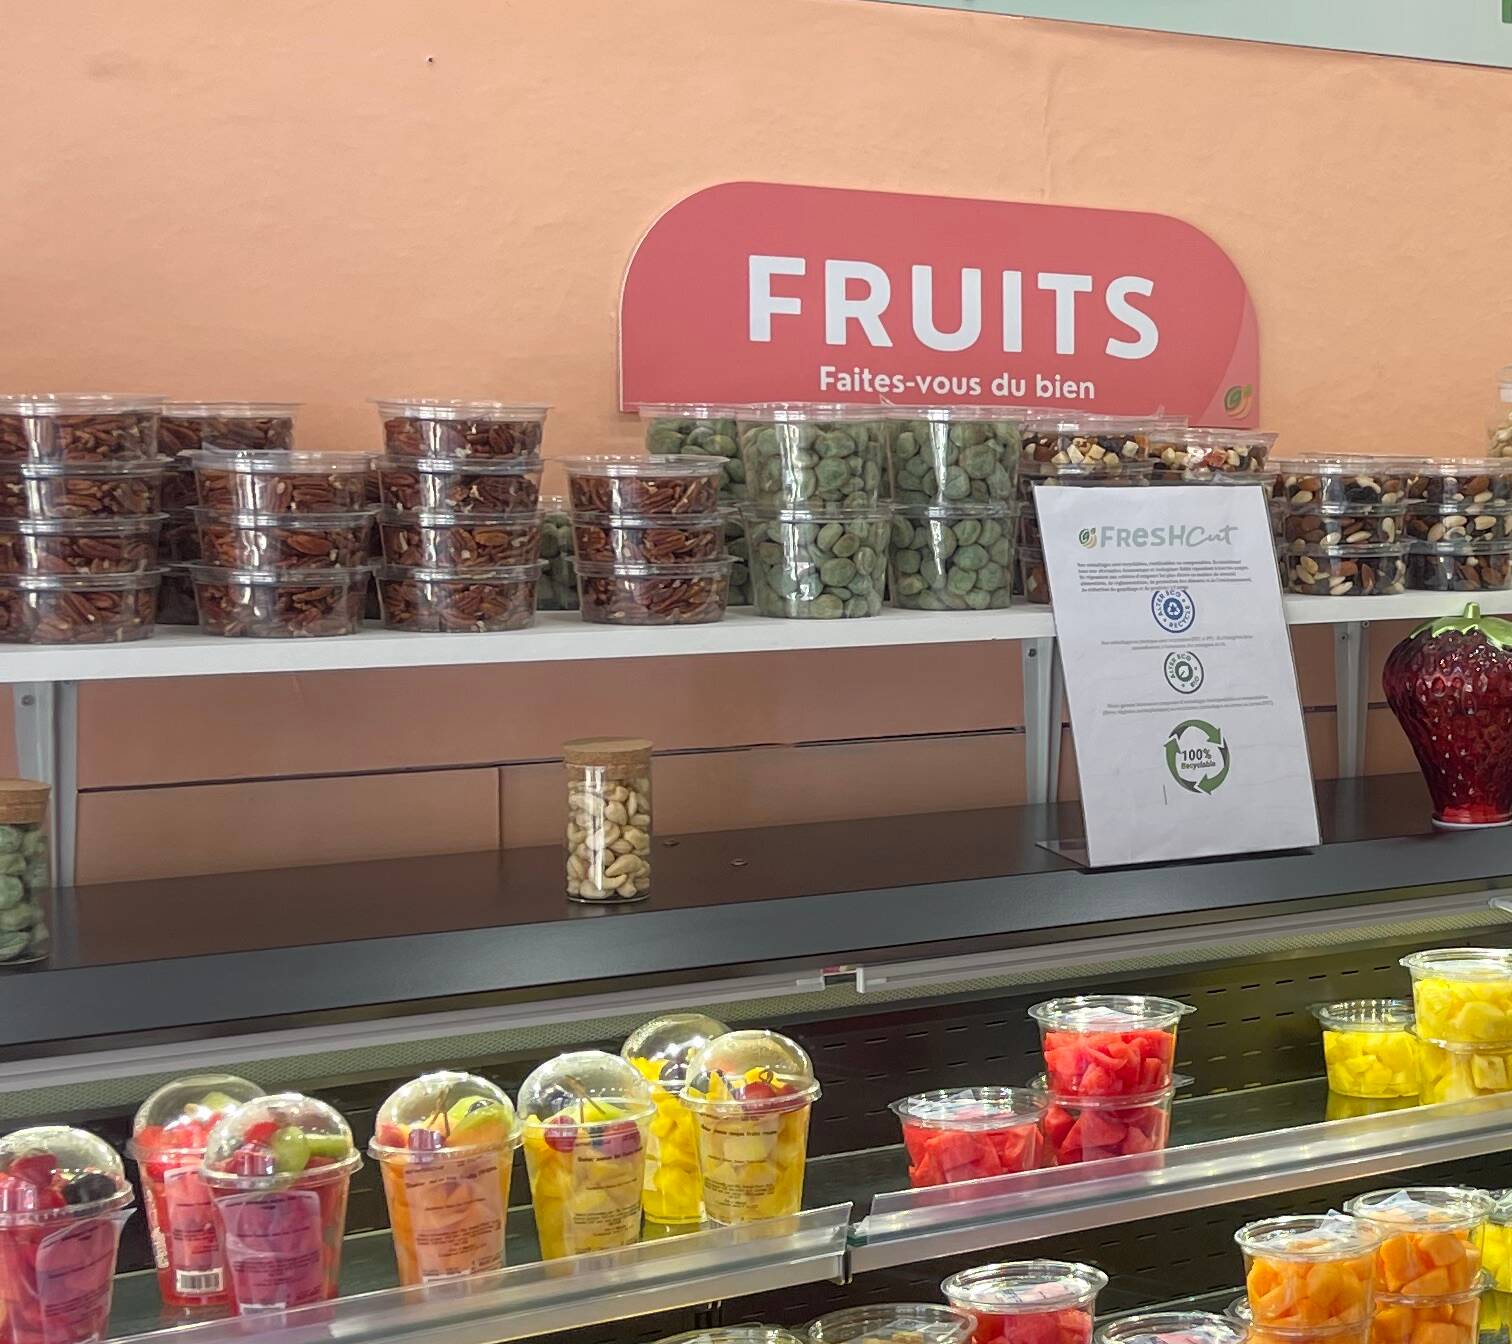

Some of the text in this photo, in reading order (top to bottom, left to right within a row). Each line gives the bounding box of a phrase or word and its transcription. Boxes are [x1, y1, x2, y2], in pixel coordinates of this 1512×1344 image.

[747, 254, 1160, 360] FRUITS
[819, 364, 1096, 400] Faites-vous du bien
[1182, 748, 1212, 761] 100%
